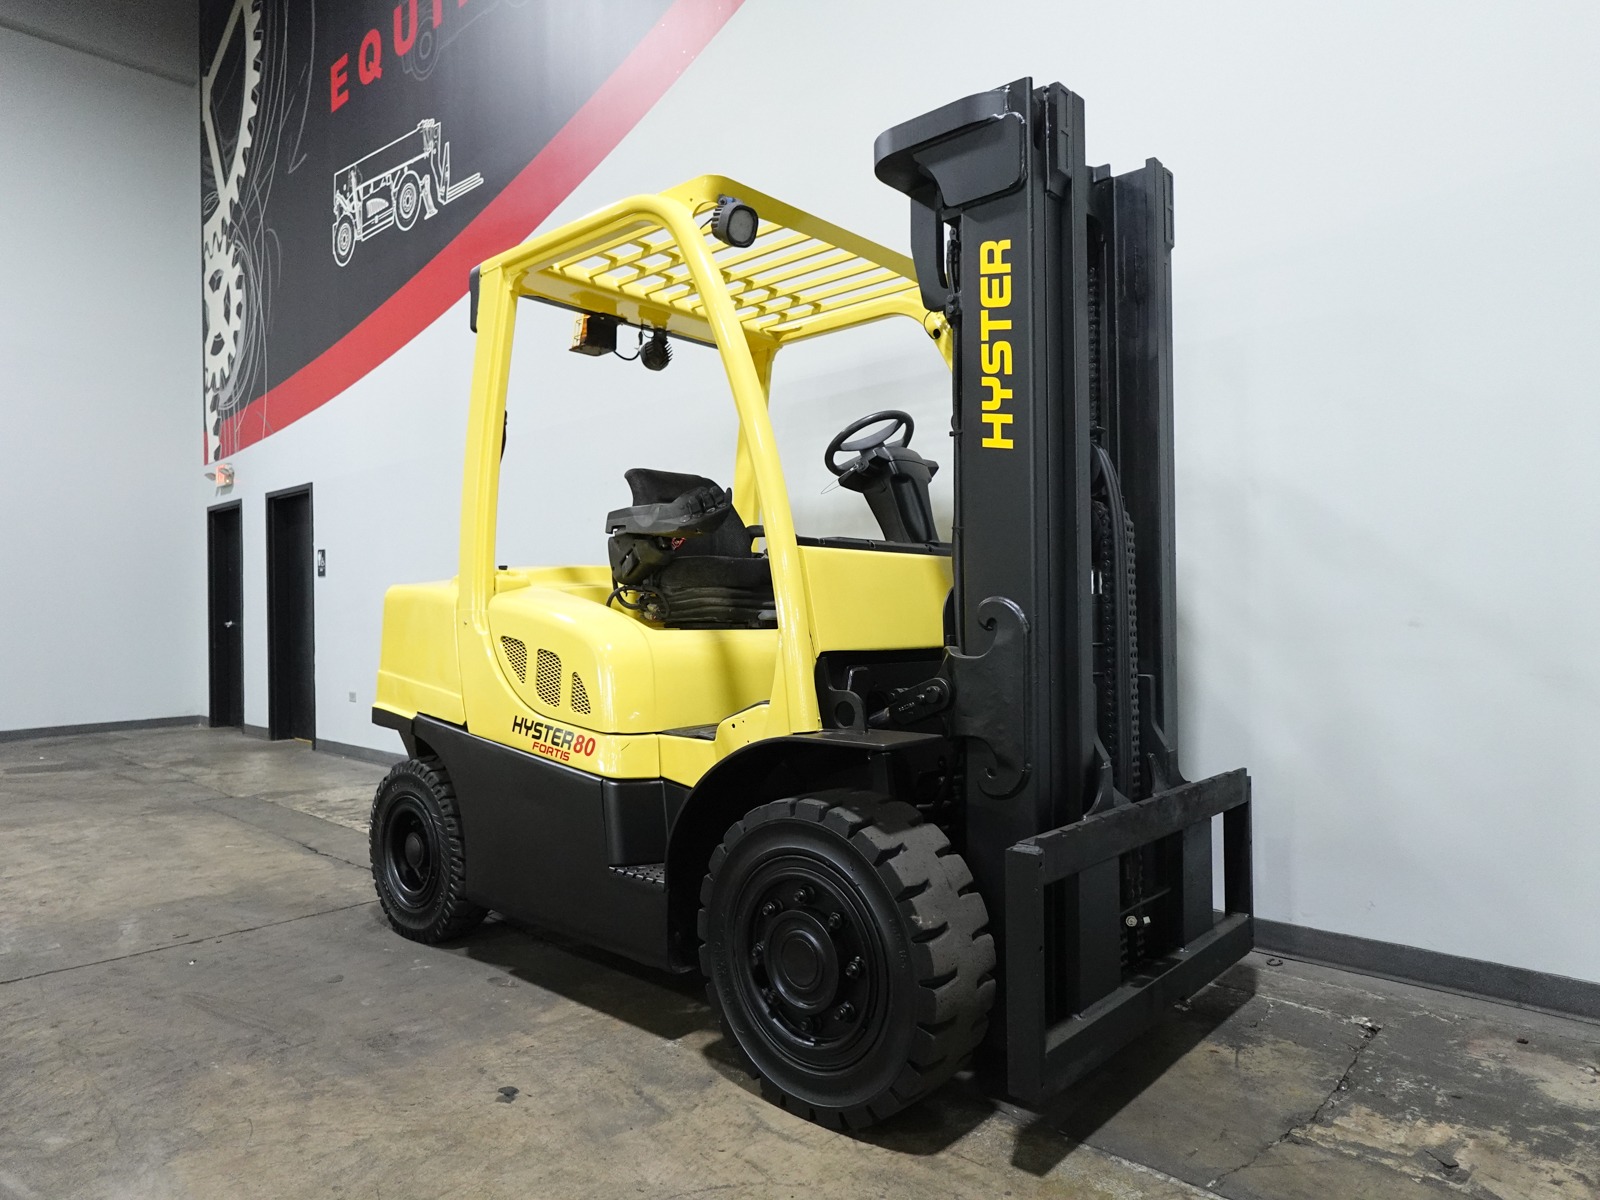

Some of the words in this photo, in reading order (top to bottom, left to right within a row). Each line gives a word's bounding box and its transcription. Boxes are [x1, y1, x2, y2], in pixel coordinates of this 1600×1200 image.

[330, 0, 468, 113] EQUI
[979, 239, 1014, 449] HYSTER
[532, 741, 571, 762] FORTIS
